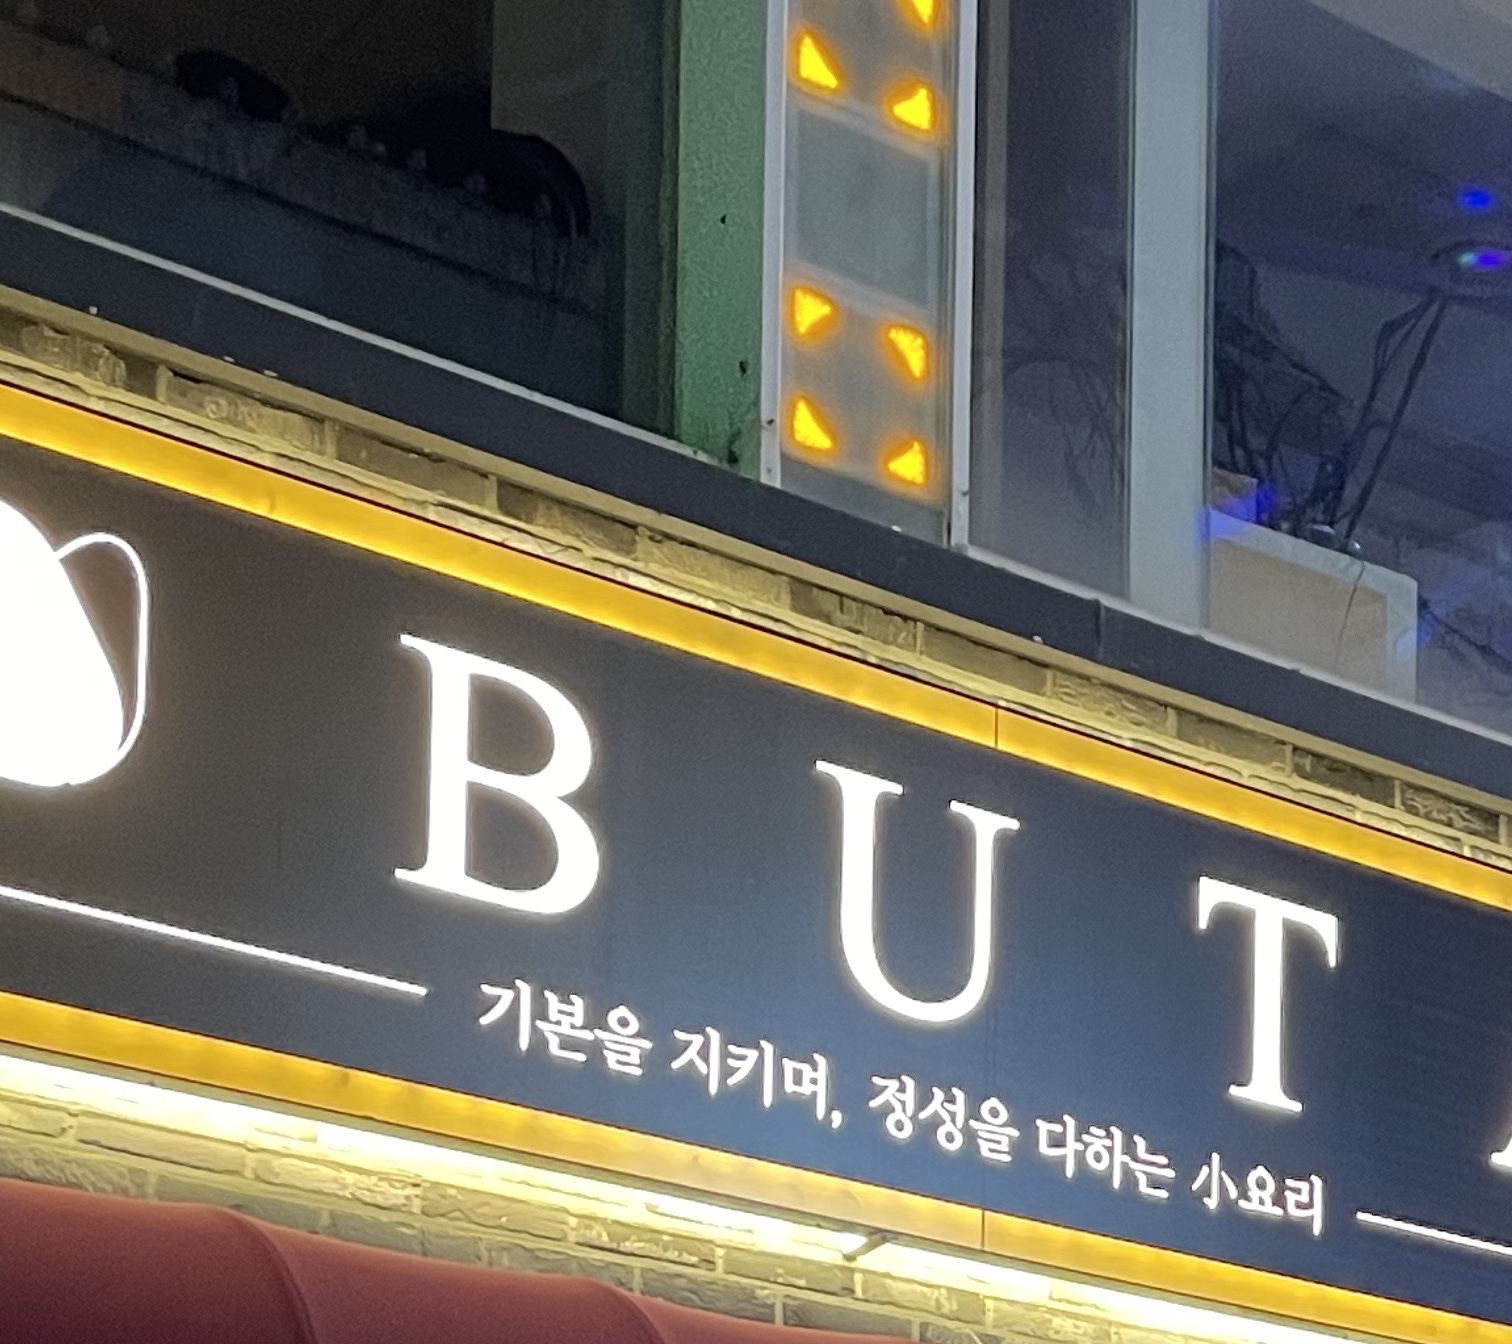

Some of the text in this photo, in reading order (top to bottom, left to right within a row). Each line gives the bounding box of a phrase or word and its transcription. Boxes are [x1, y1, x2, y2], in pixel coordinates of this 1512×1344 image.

[478, 978, 1326, 1236] 기본을 지키며, 정성을 다하는 小요리
